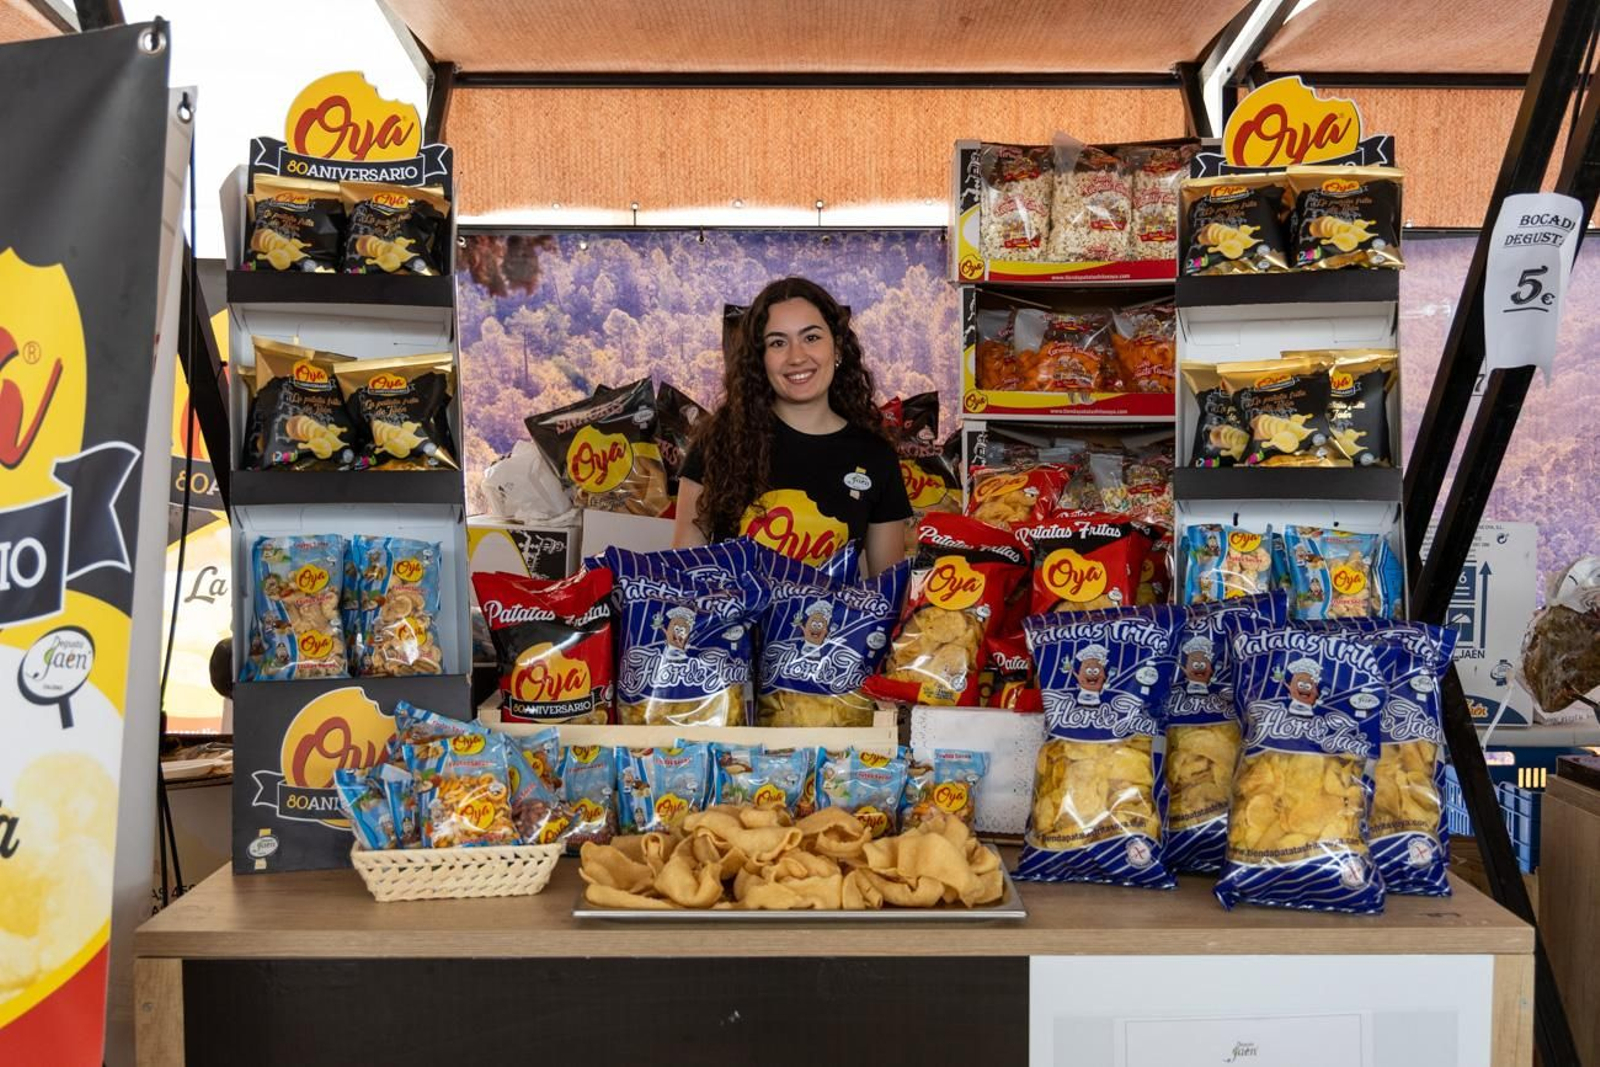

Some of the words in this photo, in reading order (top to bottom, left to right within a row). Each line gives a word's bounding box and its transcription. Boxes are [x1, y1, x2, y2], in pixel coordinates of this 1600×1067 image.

[294, 95, 414, 161] Oya
[1233, 103, 1352, 167] Oya
[572, 441, 627, 486] Oya
[747, 506, 844, 562] Oya
[1015, 524, 1073, 548] Patatas
[1074, 520, 1122, 540] Fritas
[184, 565, 228, 605] La
[926, 563, 983, 602] Oya
[1047, 558, 1103, 595] Oya
[484, 600, 557, 627] Patatas
[1234, 628, 1319, 660] Patatas
[515, 660, 587, 701] Oya
[292, 716, 397, 789] Oy
